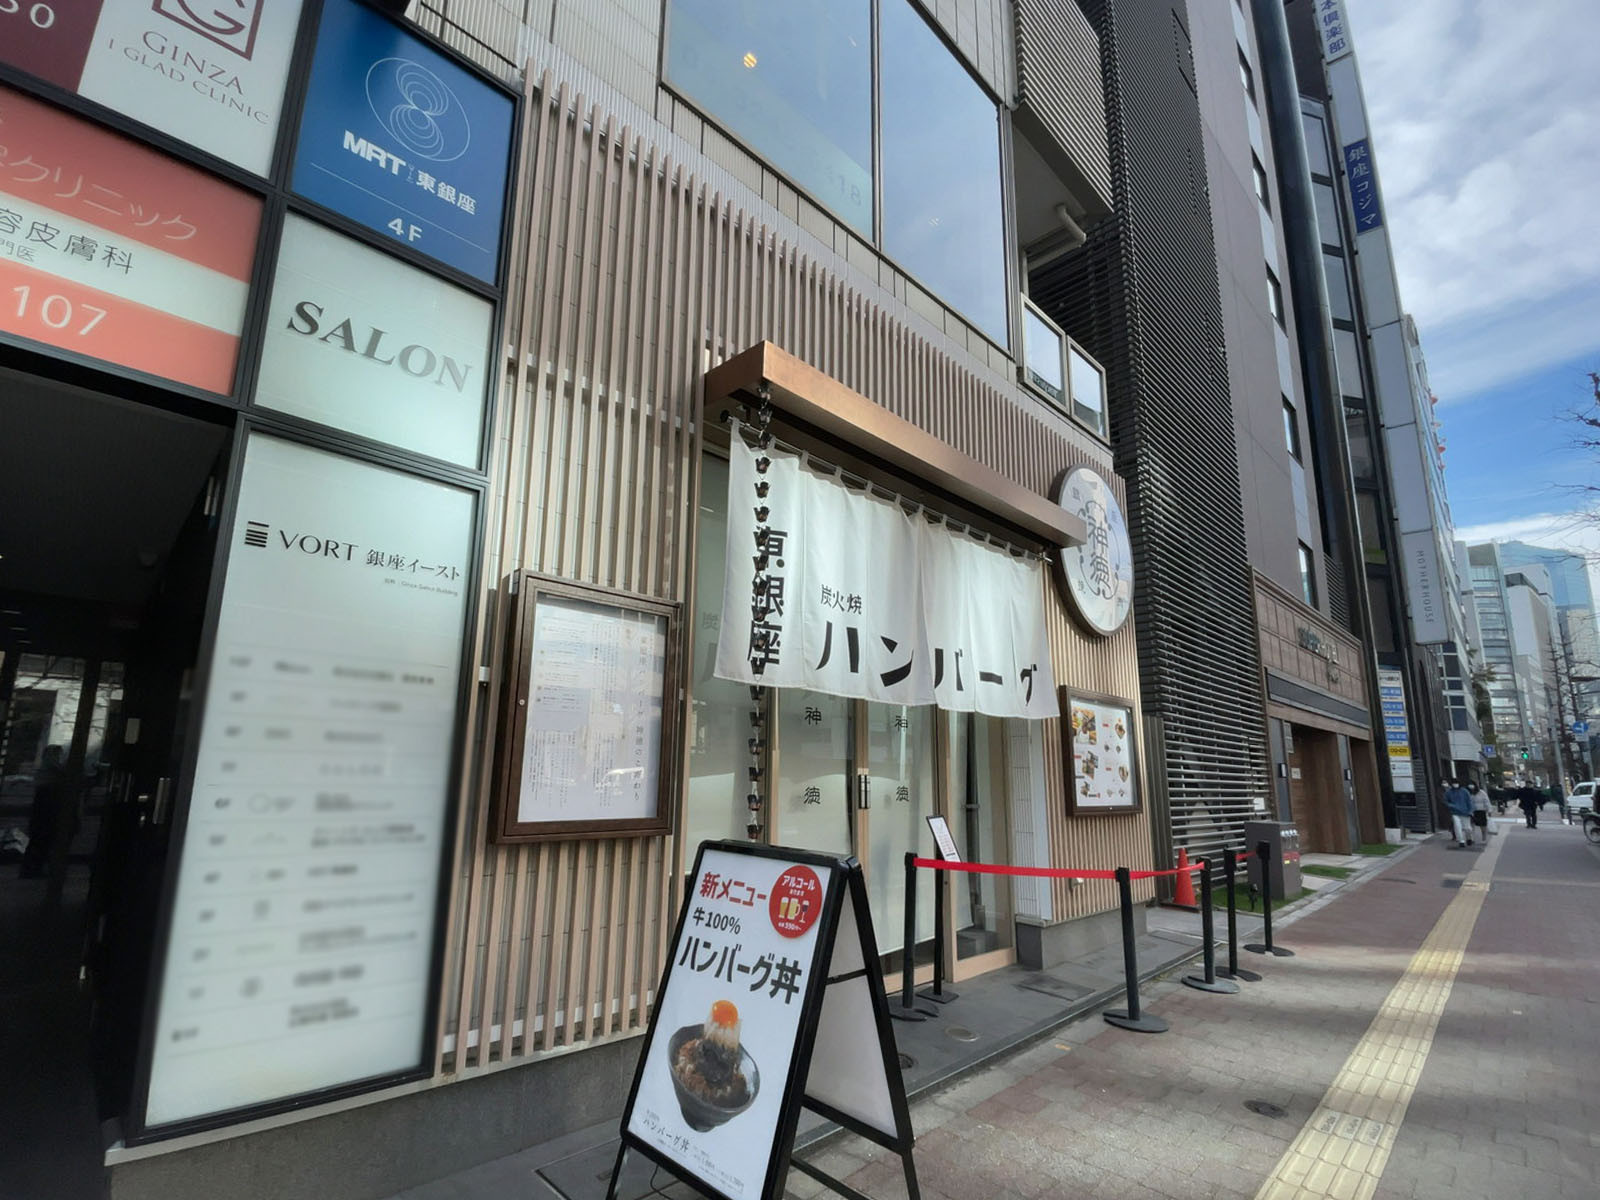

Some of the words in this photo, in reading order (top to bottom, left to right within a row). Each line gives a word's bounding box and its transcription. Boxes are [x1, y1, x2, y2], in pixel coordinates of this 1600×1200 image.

[123, 47, 186, 83] GLAD
[192, 80, 270, 125] CLINIC
[142, 30, 244, 96] GINZA
[0, 144, 197, 241] クリニック
[342, 129, 407, 176] MRT
[415, 169, 477, 216] 東銀座
[1347, 147, 1377, 226] 銀座コジマ
[387, 217, 423, 242] 4F
[13, 285, 108, 336] 107
[286, 300, 473, 394] SALON
[279, 529, 360, 562] VORT
[365, 548, 461, 581] 銀座イースト
[1416, 550, 1435, 623] MOTHERHOUSE
[820, 583, 863, 616] 炭火焼
[815, 619, 1038, 707] ハンバーグ
[699, 871, 767, 908] 新メニュー
[781, 874, 816, 892] アルコール
[692, 906, 741, 935] 牛100%
[678, 935, 803, 1005] ハンバーグ丼
